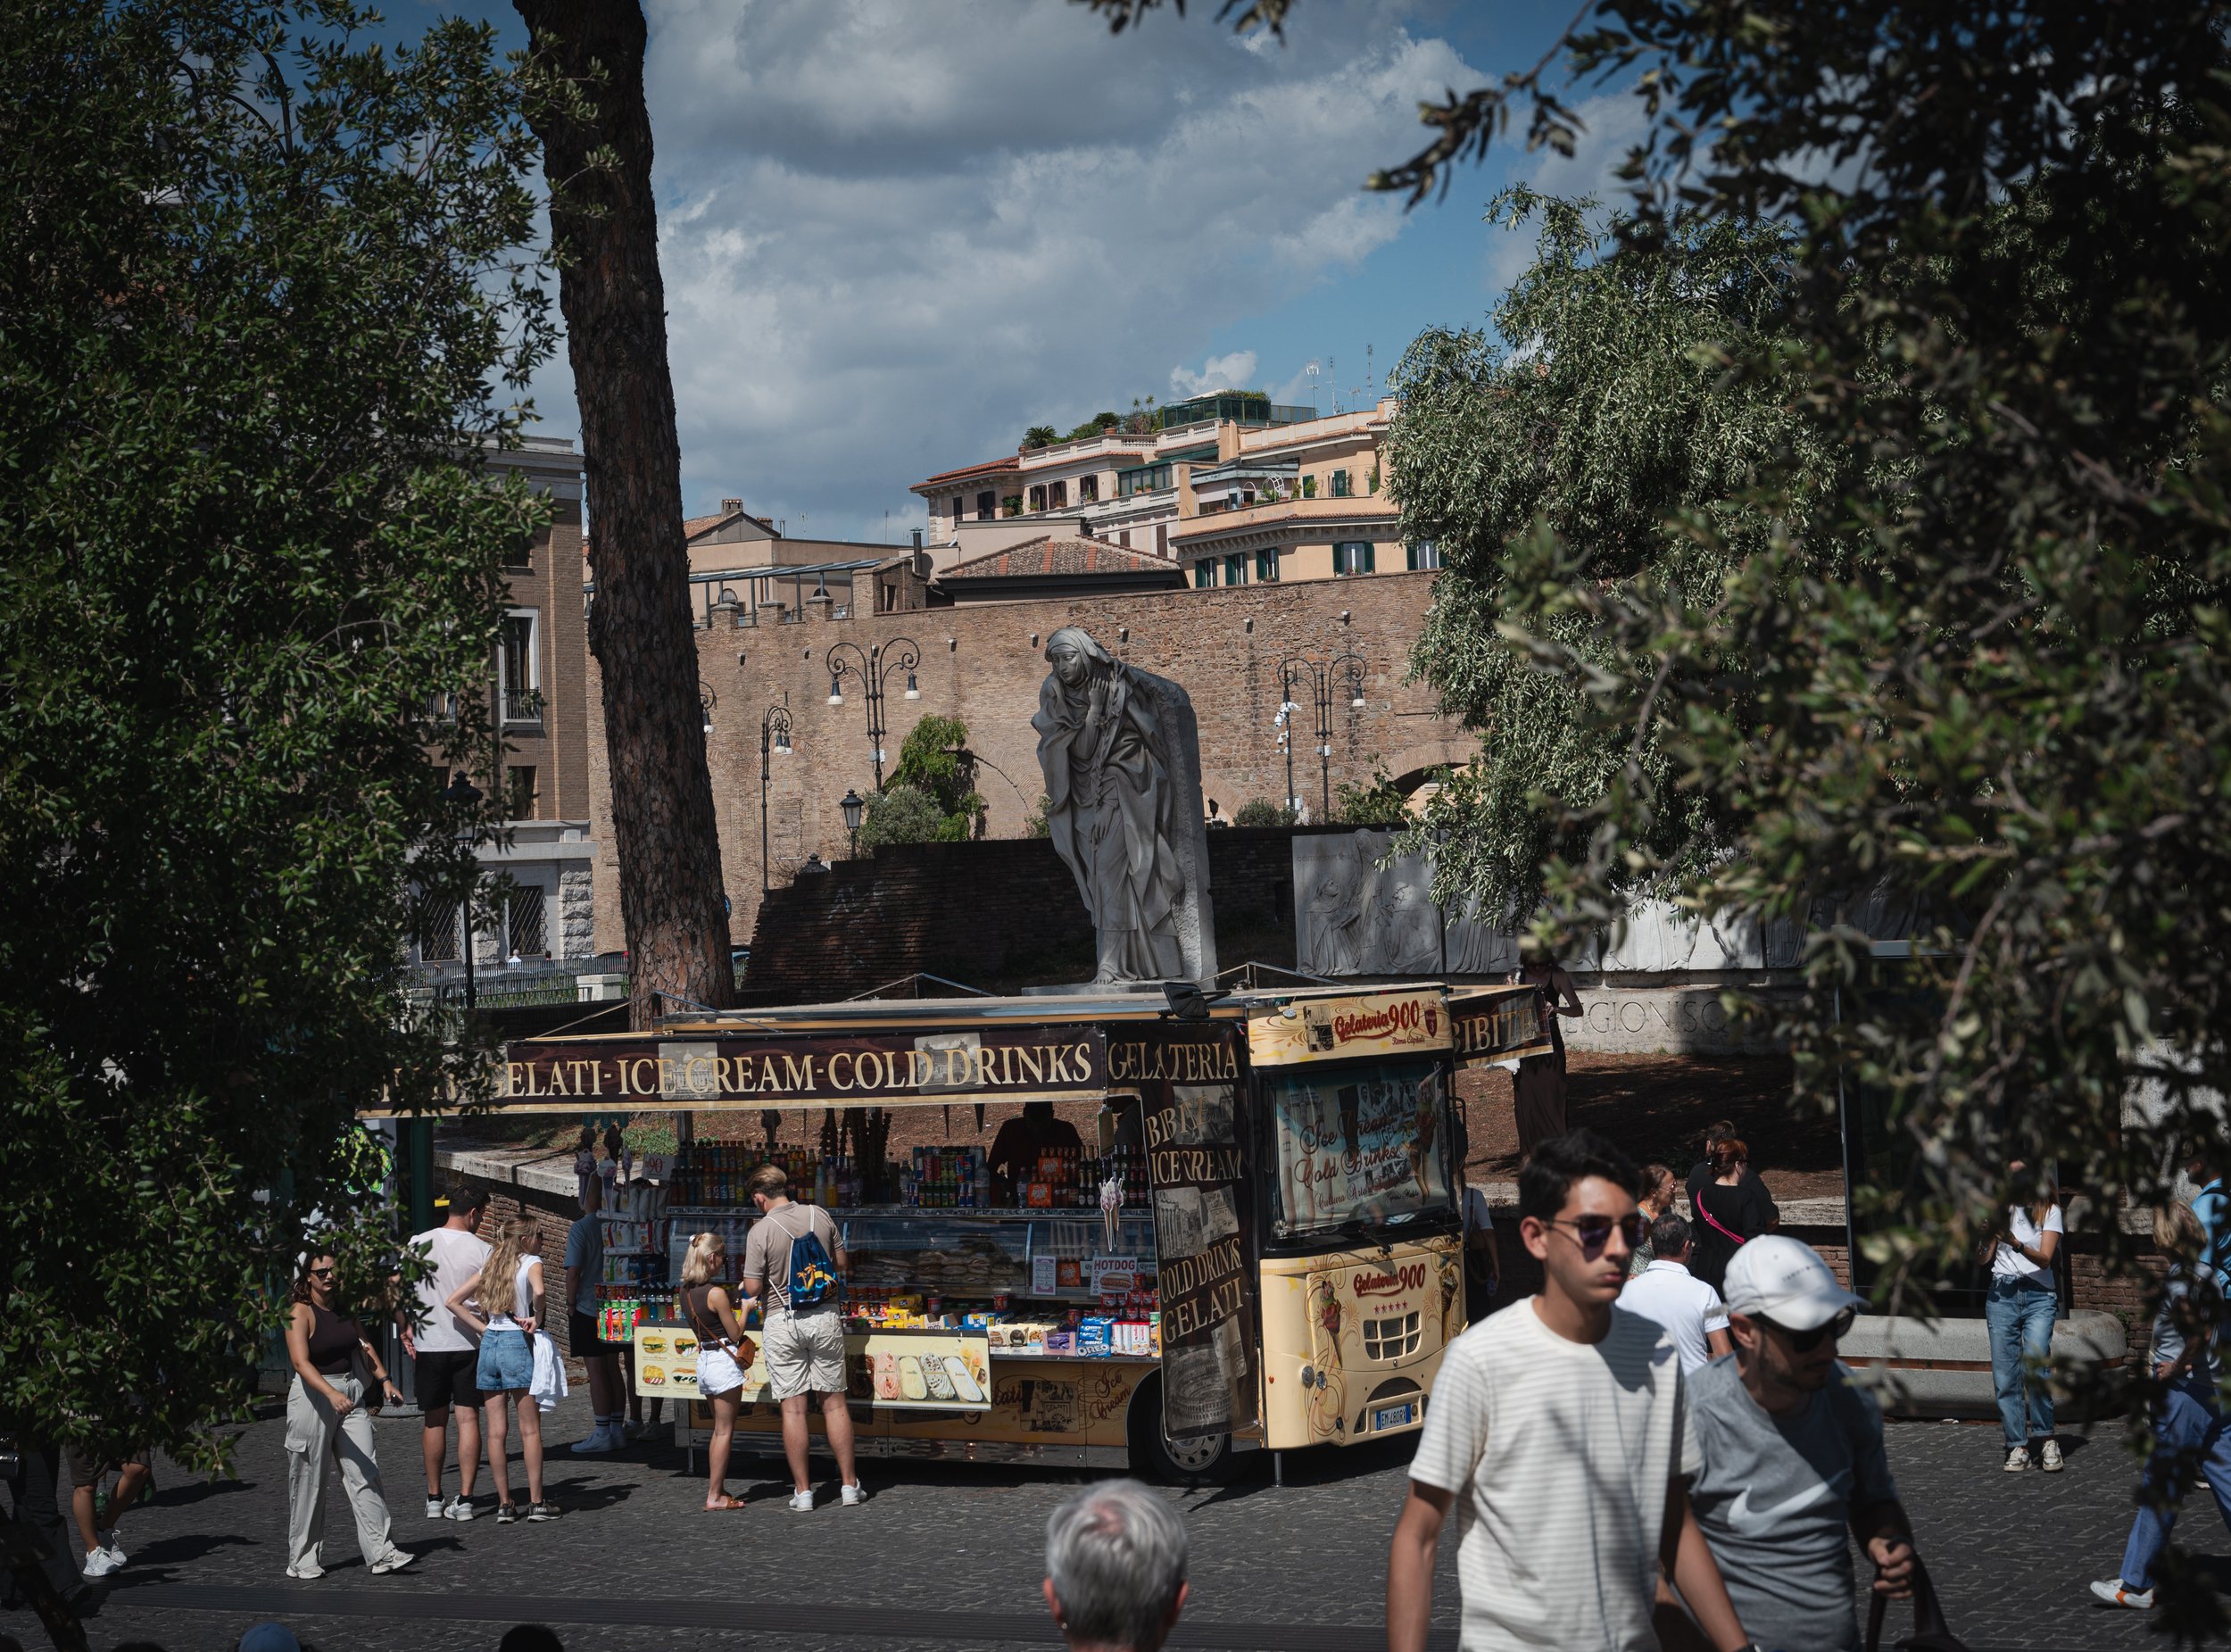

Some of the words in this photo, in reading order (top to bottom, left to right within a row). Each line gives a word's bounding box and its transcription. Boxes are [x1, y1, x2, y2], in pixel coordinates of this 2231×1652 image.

[944, 1042, 1091, 1086] DRINKS
[1107, 1042, 1240, 1081] GELATERIA
[1093, 1259, 1135, 1270] HOTDOG
[1160, 1259, 1194, 1304] COLD
[1163, 1276, 1244, 1344] GELATI
[1077, 1342, 1110, 1357] OREO
[1095, 1370, 1123, 1399] Ice
